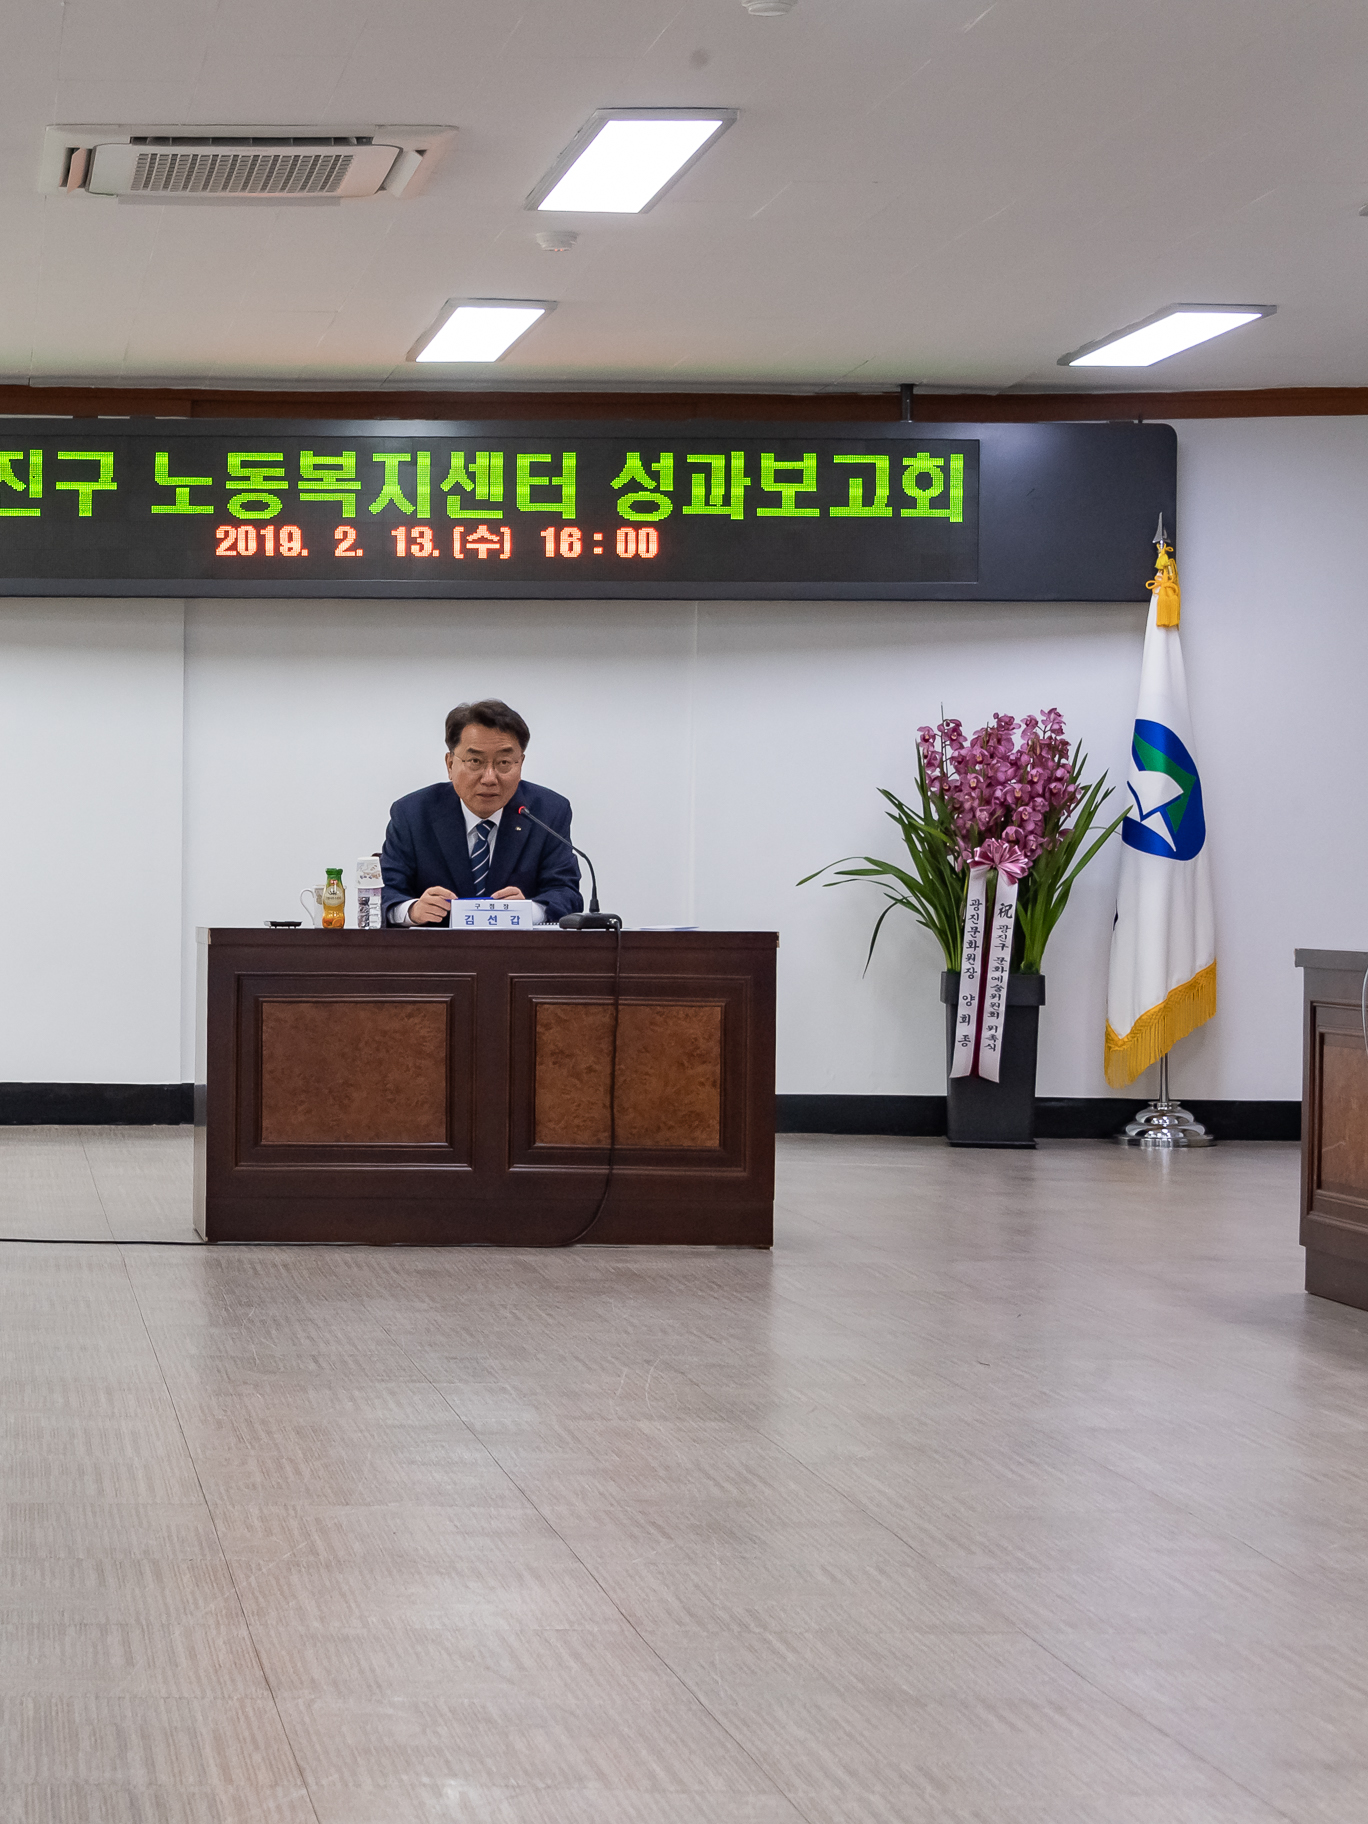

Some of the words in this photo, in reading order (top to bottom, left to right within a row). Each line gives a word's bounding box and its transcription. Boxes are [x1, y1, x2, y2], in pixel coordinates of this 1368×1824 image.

[150, 450, 577, 520] 노동복지센터
[609, 450, 964, 522] 성과보고회
[215, 525, 309, 557] 2019.
[333, 526, 363, 557] 2.
[997, 902, 1013, 919] 祝
[994, 924, 1011, 951] 광진구
